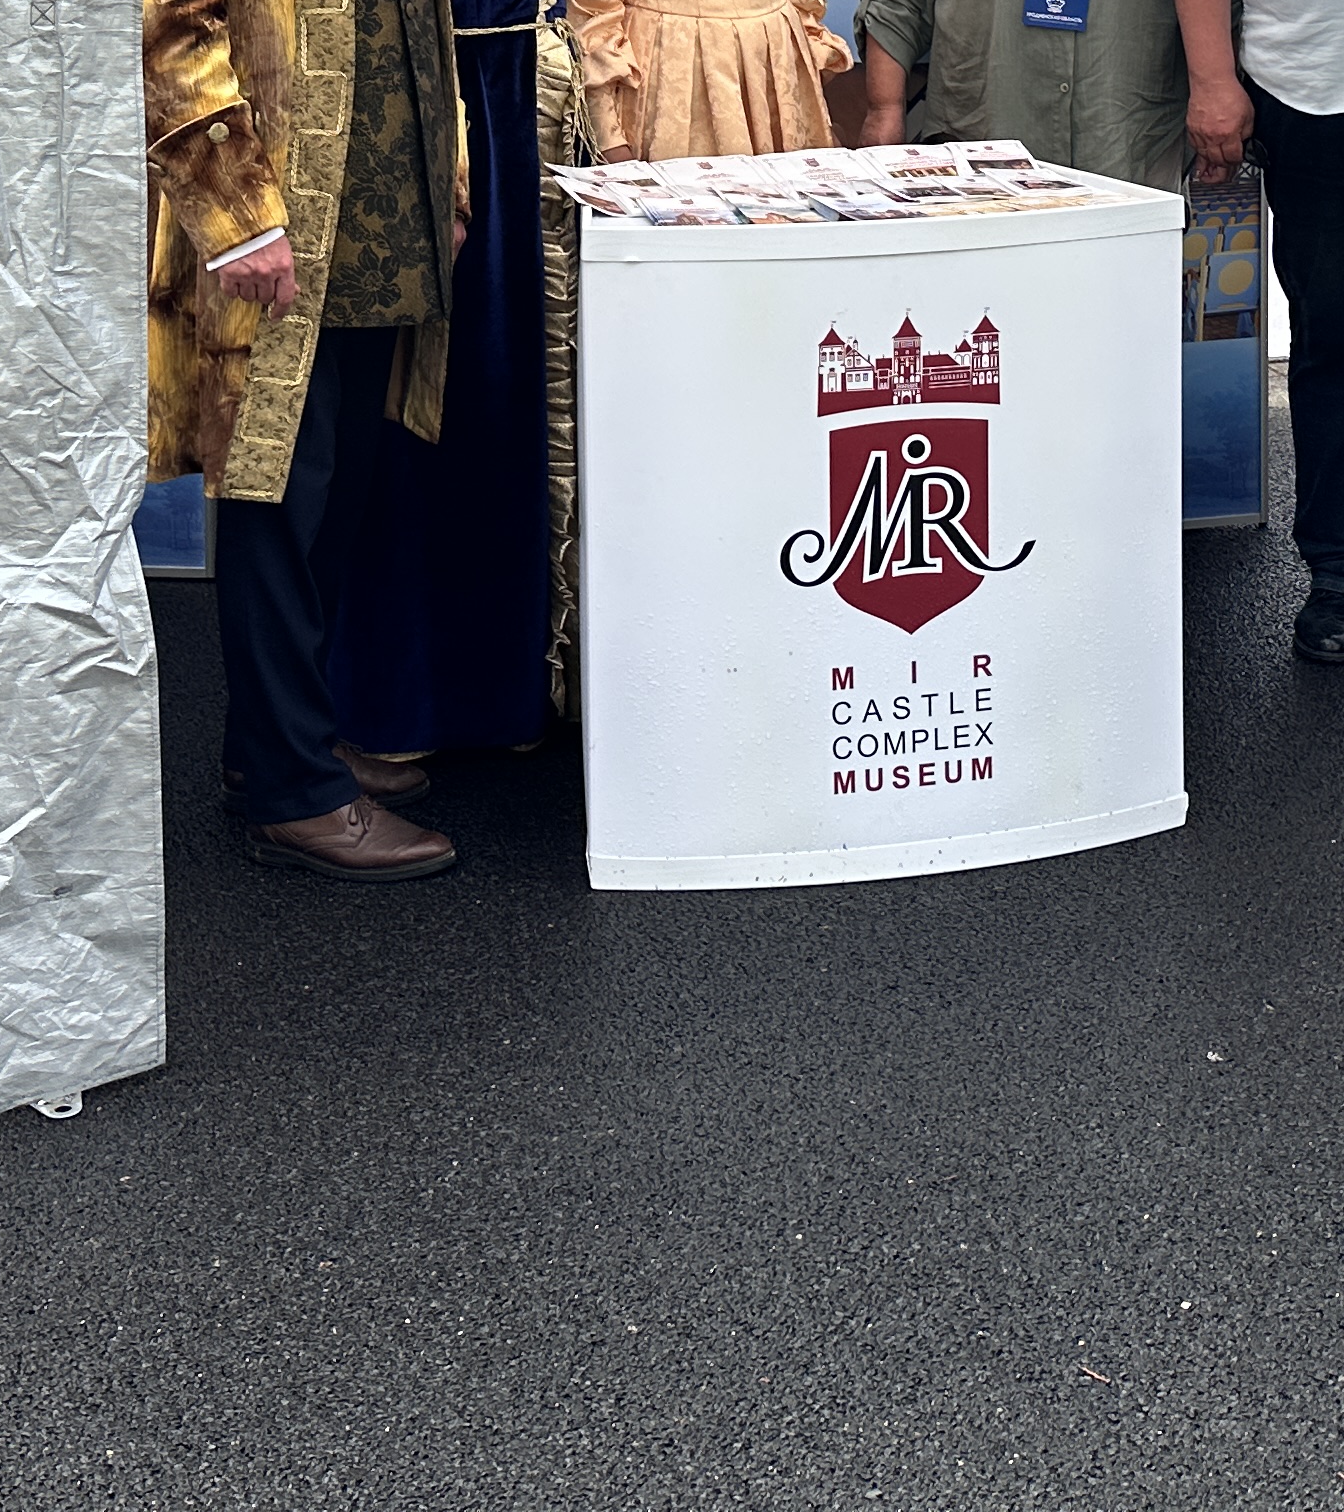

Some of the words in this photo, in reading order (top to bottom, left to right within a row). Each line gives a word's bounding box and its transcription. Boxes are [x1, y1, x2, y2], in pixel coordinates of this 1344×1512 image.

[831, 688, 993, 726] CASTLE
[832, 722, 994, 760] COMPLEX
[833, 756, 994, 795] MUSEUM
